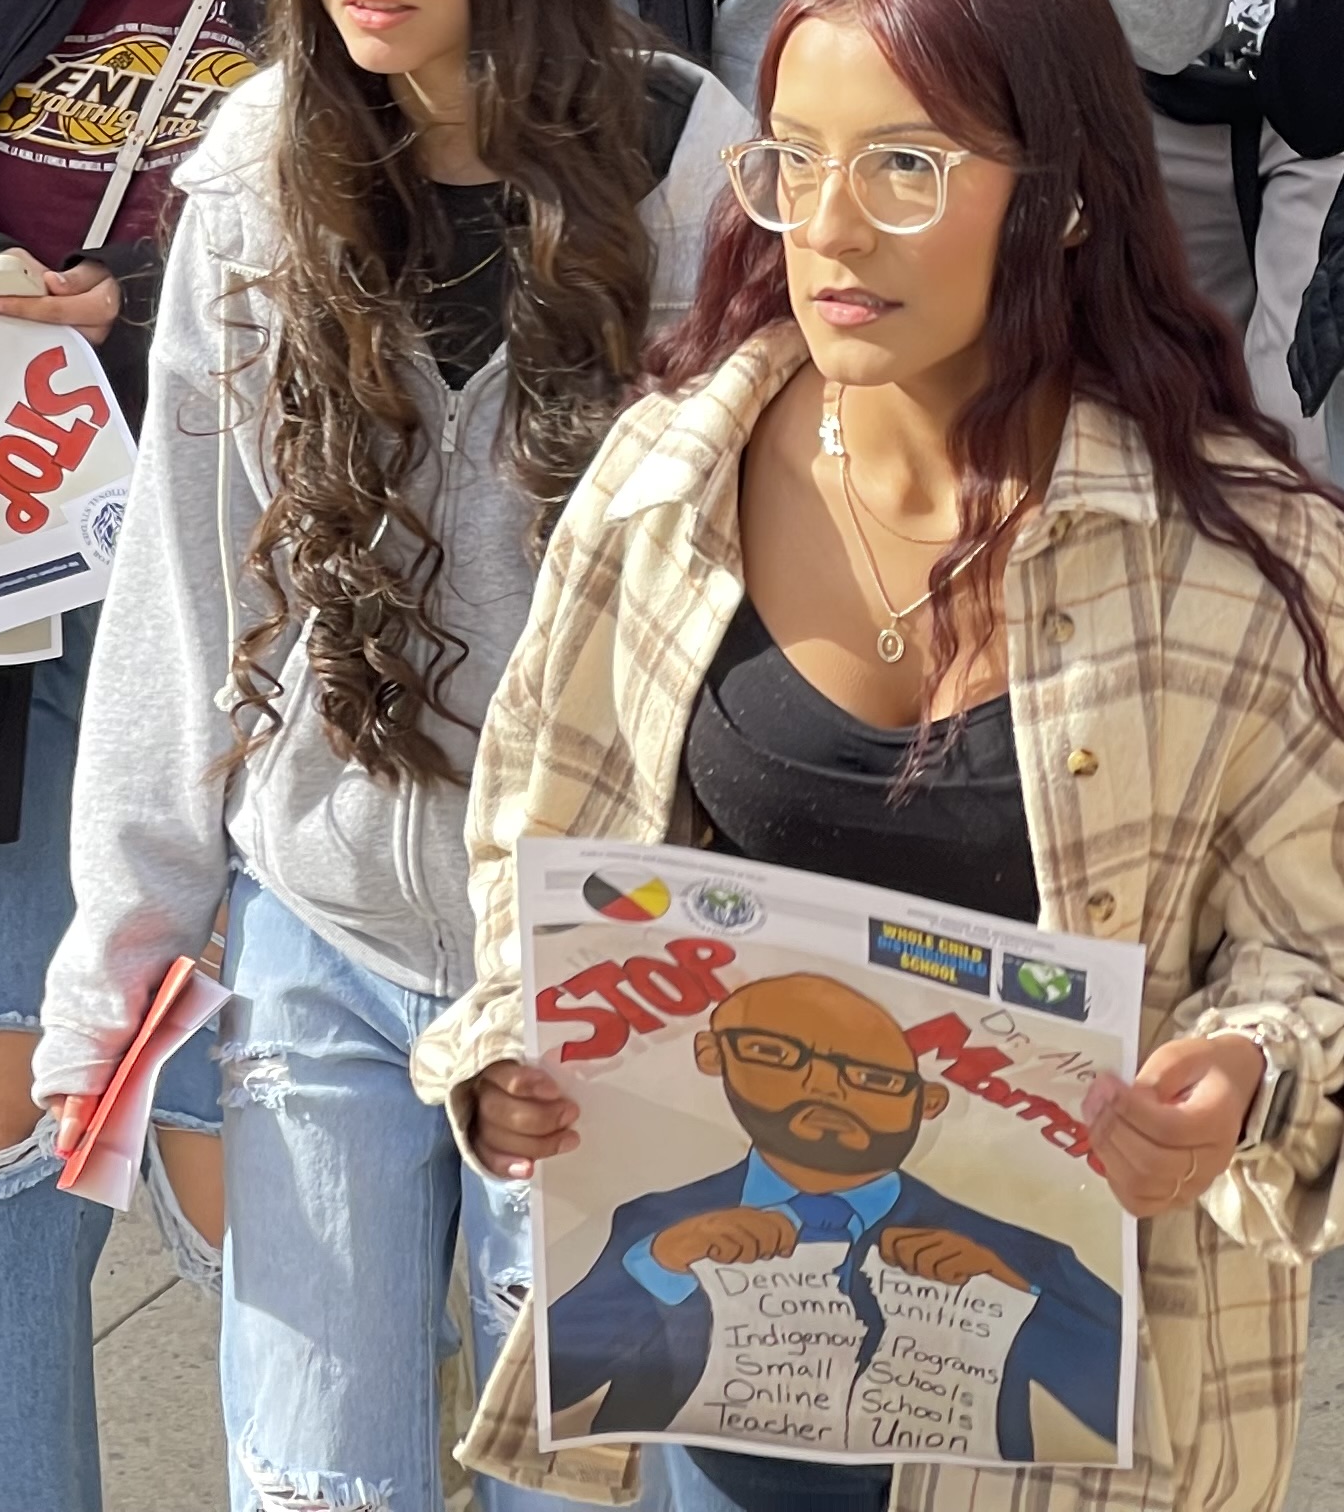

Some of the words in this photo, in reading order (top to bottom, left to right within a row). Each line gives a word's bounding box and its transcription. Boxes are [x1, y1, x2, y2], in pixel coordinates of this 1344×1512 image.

[30, 90, 110, 126] YOUTH
[882, 923, 935, 949] WHOLE
[938, 936, 984, 962] CHILD
[899, 952, 958, 984] SCHOOL
[535, 936, 737, 1064] STOP
[979, 1008, 1031, 1049] Dr.
[1037, 1050, 1097, 1083] Ale
[902, 1012, 1109, 1180] Morrer
[714, 1267, 837, 1297] Denver
[877, 1268, 1004, 1319] Families
[758, 1292, 851, 1318] Comm
[883, 1302, 991, 1339] unities
[724, 1323, 864, 1356] Indigenou
[891, 1335, 998, 1386] Programs
[735, 1353, 833, 1380] Small
[871, 1361, 974, 1408] Schools
[703, 1401, 833, 1440] Teacher
[871, 1416, 969, 1454] Union
[723, 1378, 831, 1410] Online
[862, 1390, 973, 1431] Schools
